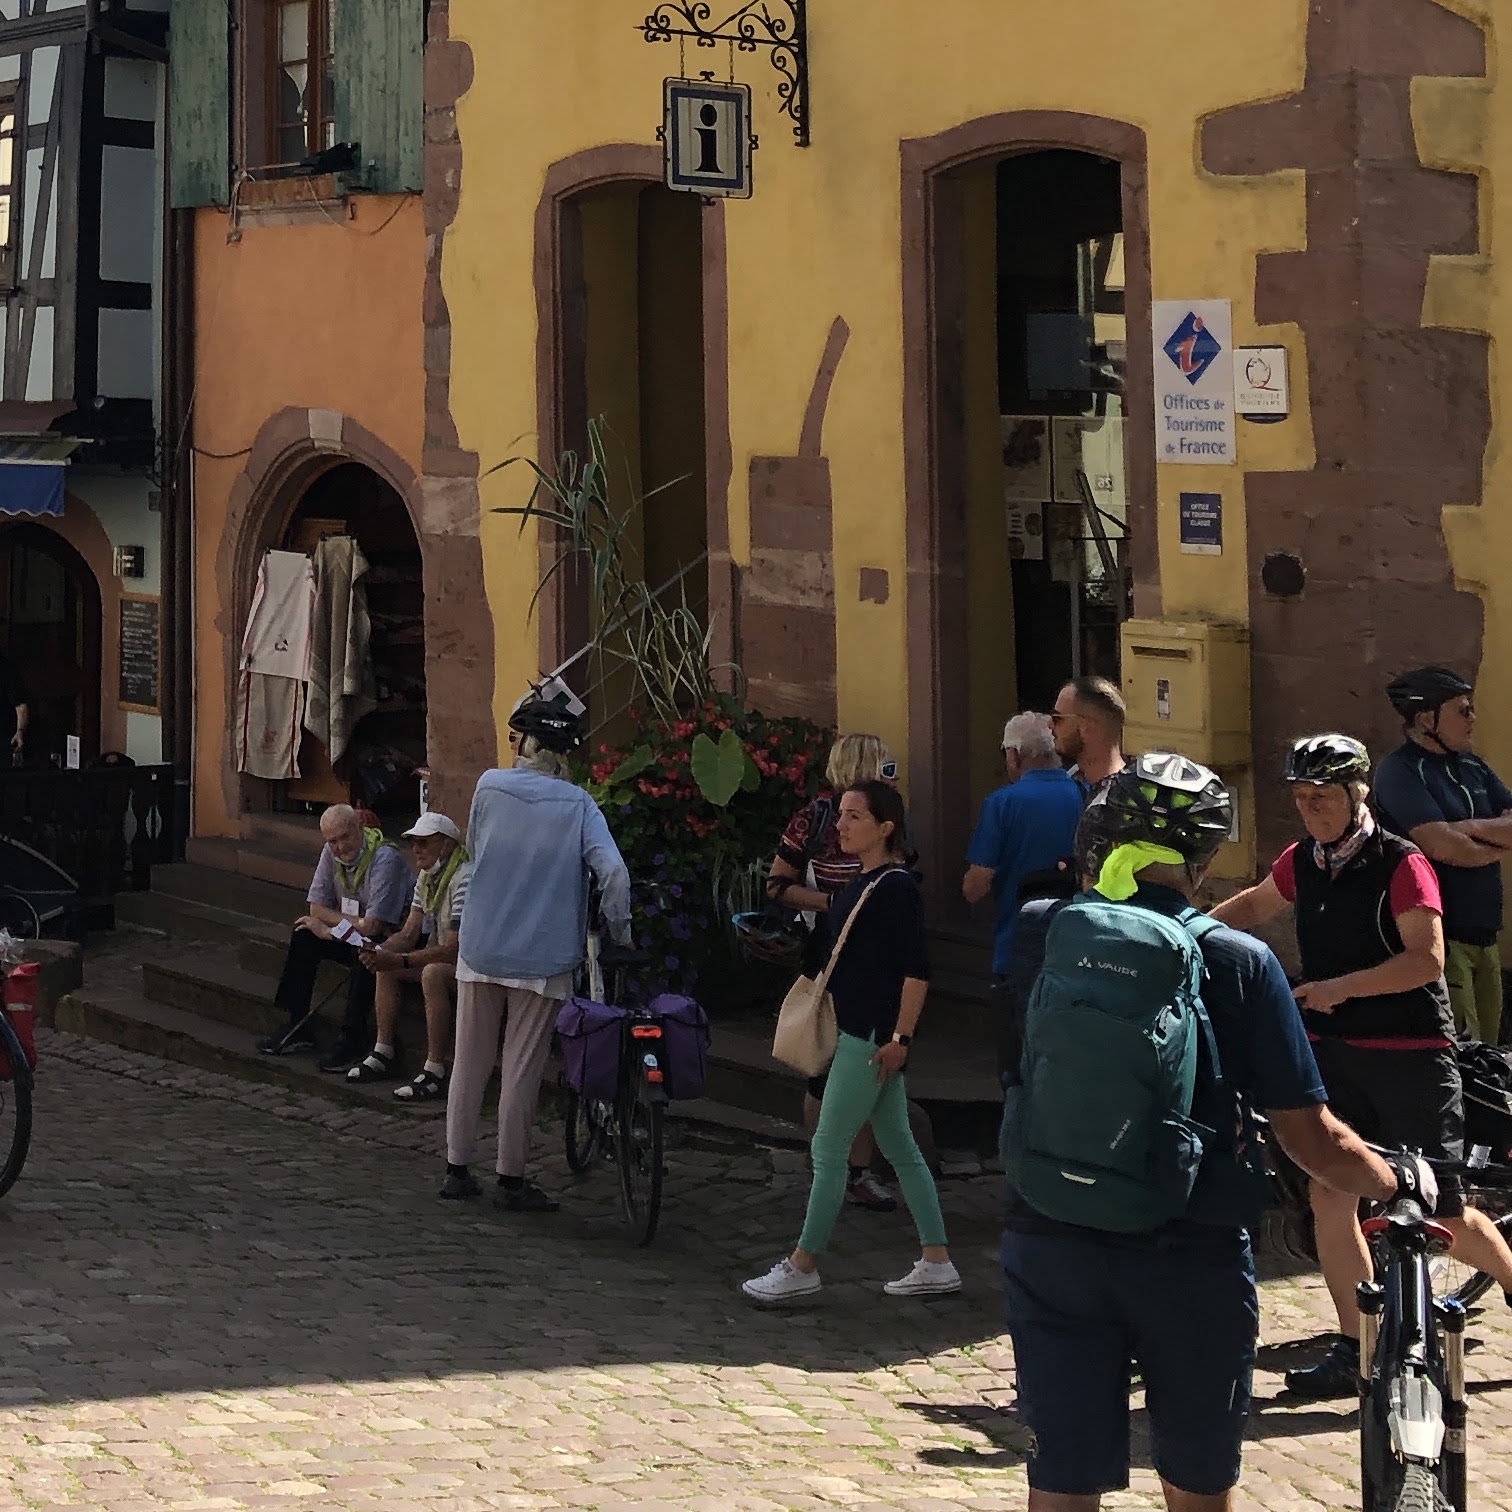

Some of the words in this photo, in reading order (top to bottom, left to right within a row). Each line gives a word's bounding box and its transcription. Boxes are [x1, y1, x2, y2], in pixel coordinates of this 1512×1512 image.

[1163, 392, 1211, 410] Offices
[1213, 400, 1225, 410] de
[1164, 415, 1226, 432] Tourisme
[1165, 443, 1176, 454] de
[1180, 437, 1227, 455] France
[1097, 961, 1138, 977] VAUDE
